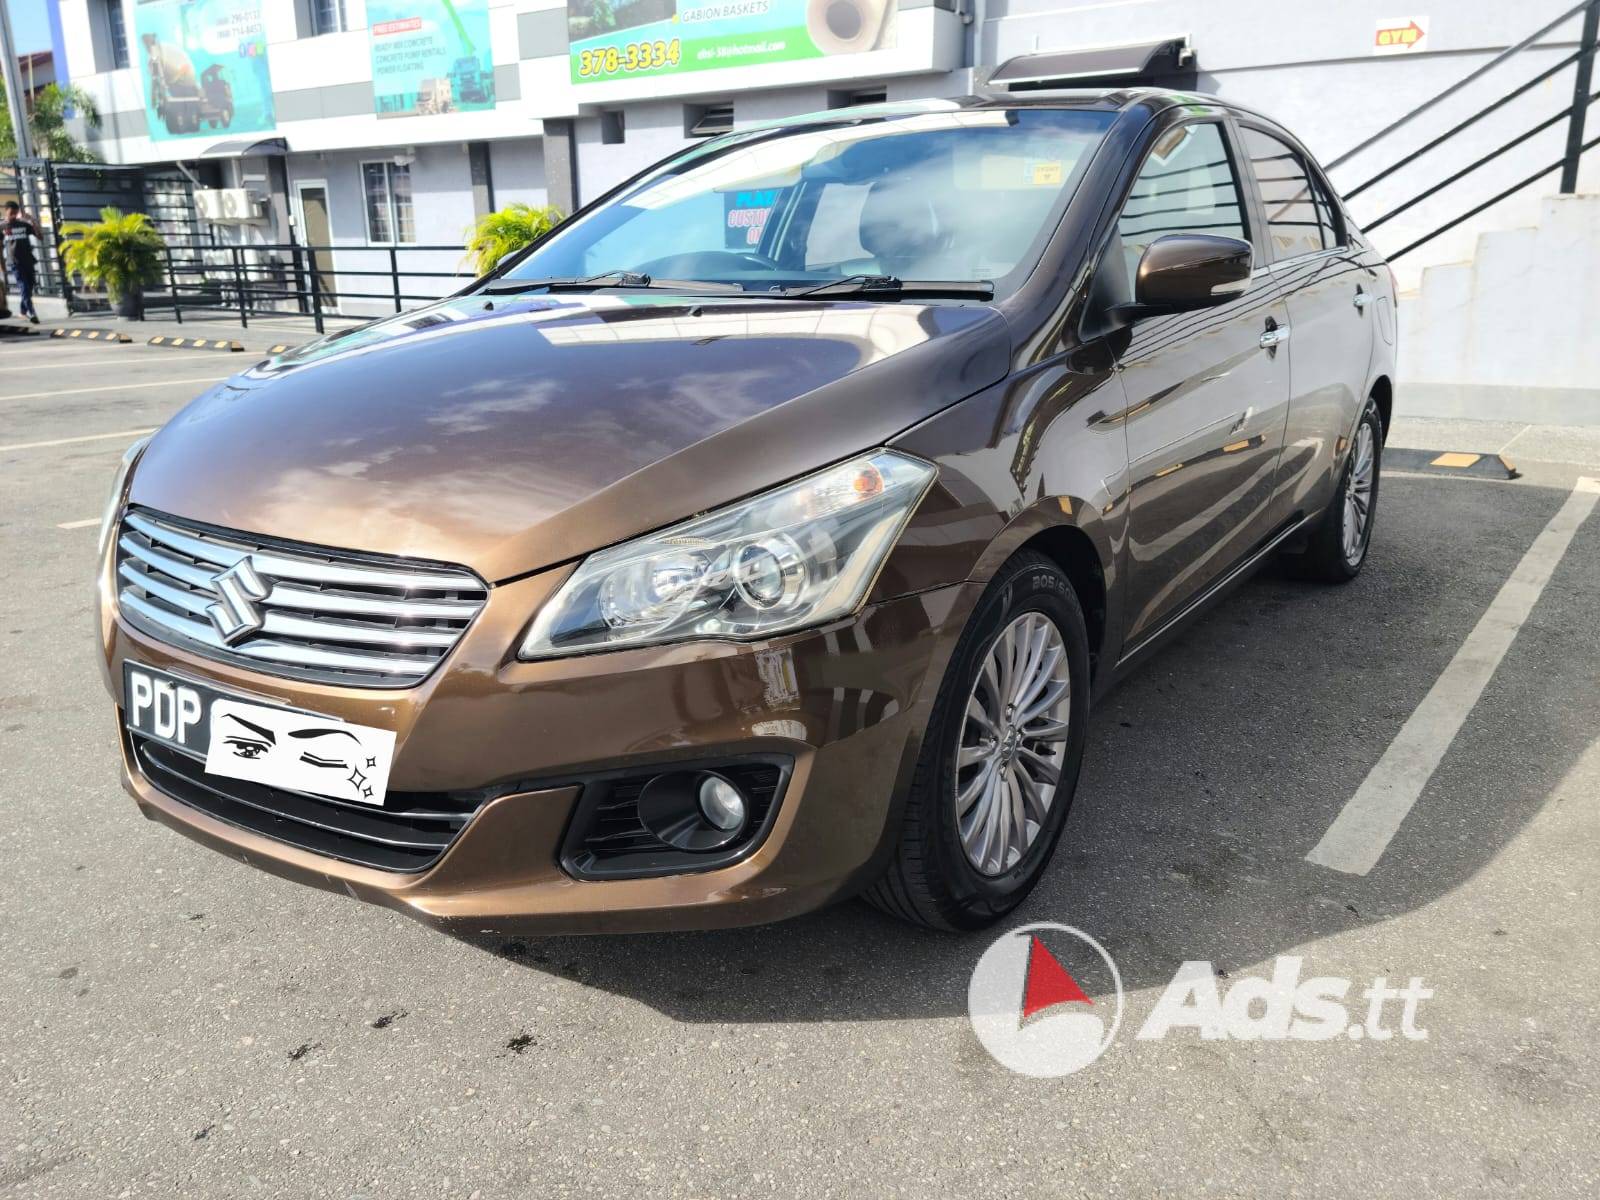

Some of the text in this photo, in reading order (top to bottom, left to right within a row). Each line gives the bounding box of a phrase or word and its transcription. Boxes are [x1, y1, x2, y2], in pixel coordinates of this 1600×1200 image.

[682, 1, 769, 22] GABION BASKETS
[403, 36, 433, 48] CONCRETE
[1378, 29, 1417, 44] GYM
[376, 52, 404, 64] CONCRETE
[421, 47, 447, 58] RENTALS
[579, 39, 681, 76] 378-3334
[728, 208, 771, 228] CUSTO
[131, 671, 202, 744] PDP
